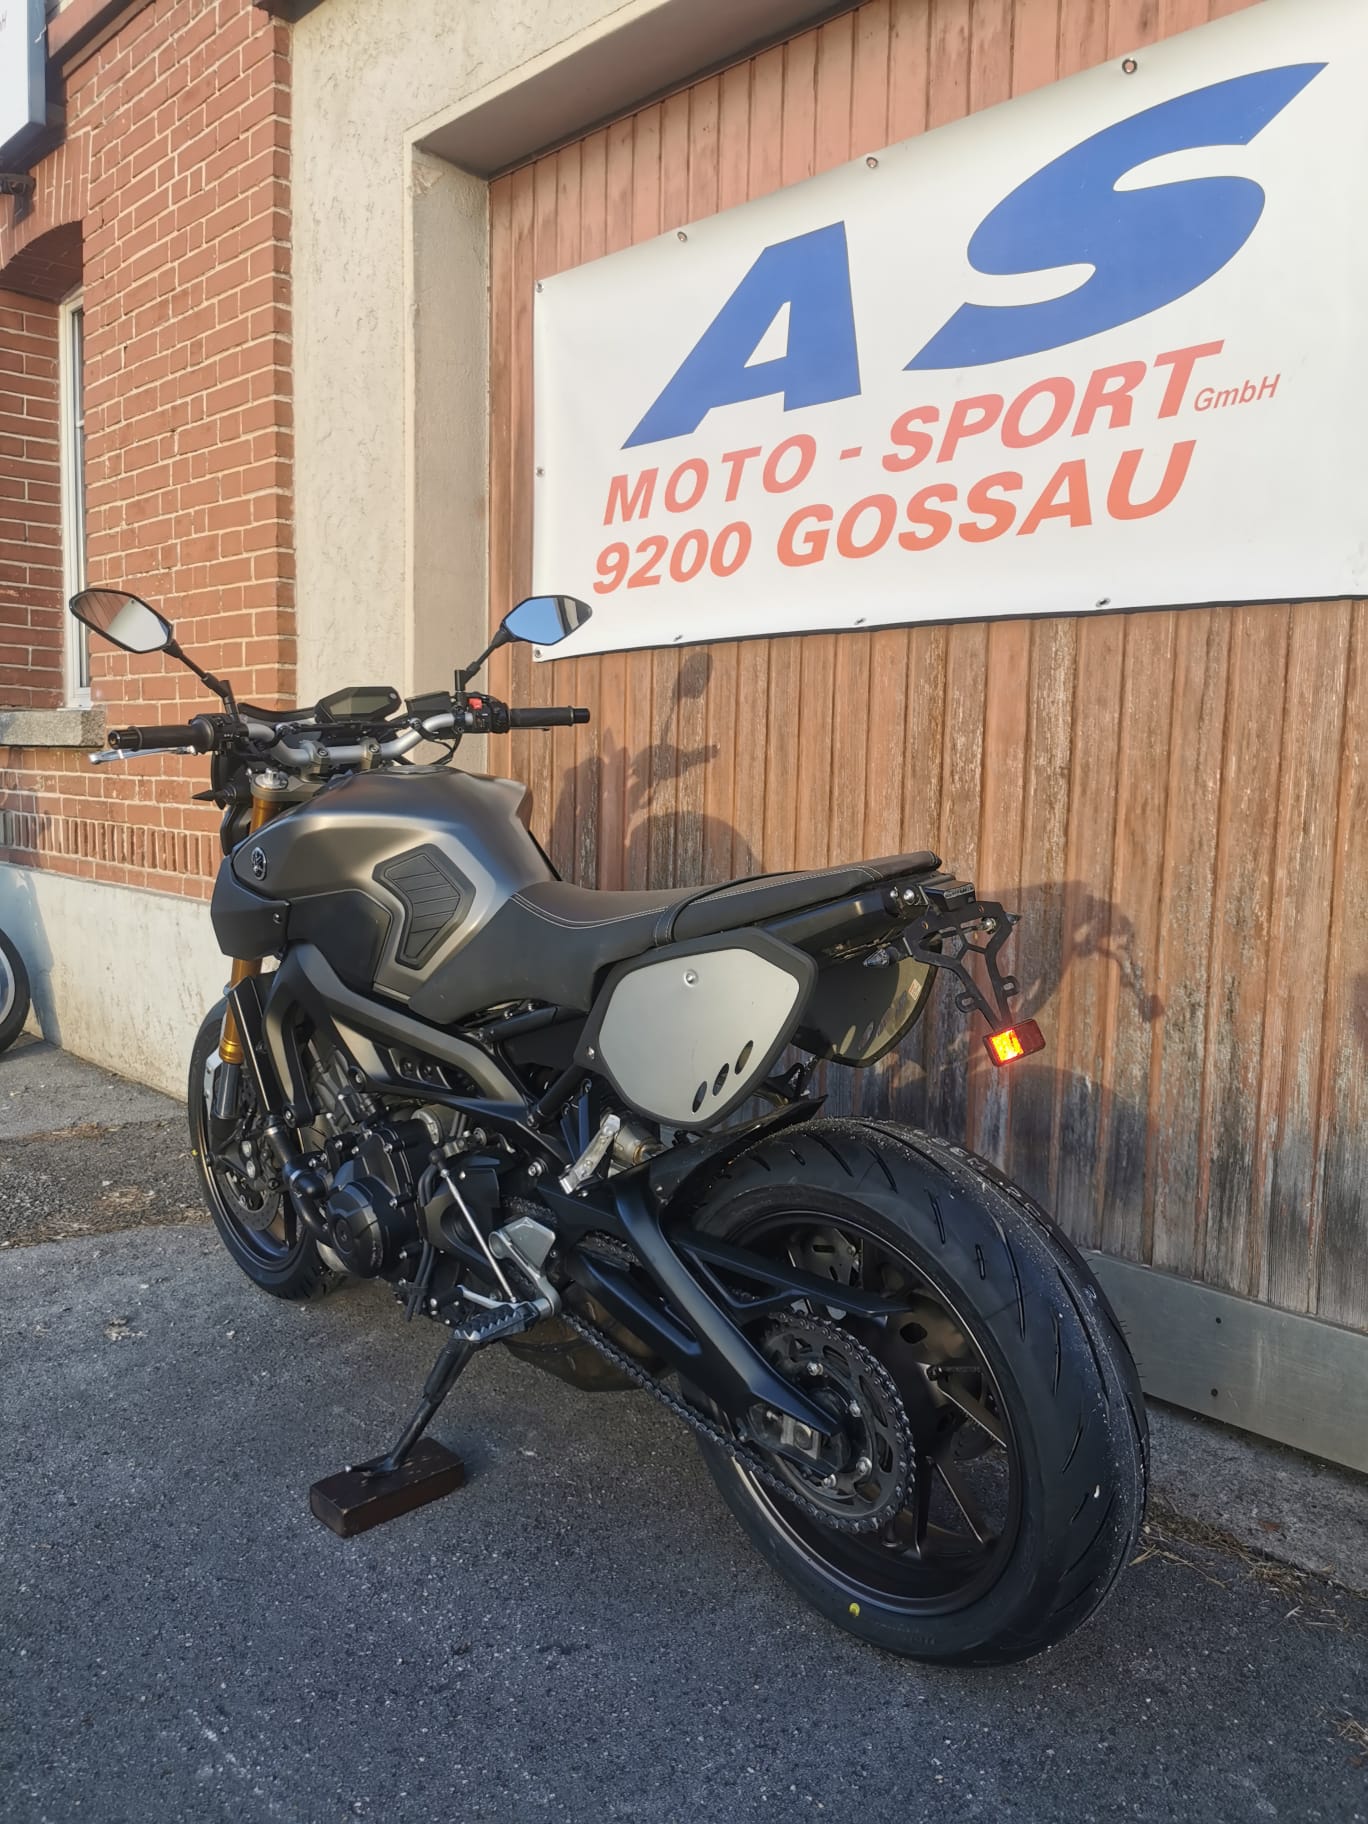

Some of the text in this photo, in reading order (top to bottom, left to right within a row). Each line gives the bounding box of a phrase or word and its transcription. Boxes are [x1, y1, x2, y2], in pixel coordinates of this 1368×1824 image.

[592, 439, 1196, 595] 9200 GOSSAU
[603, 434, 816, 526] MOTO
[881, 340, 1224, 473] SPORT
[1193, 374, 1280, 412] GmbH
